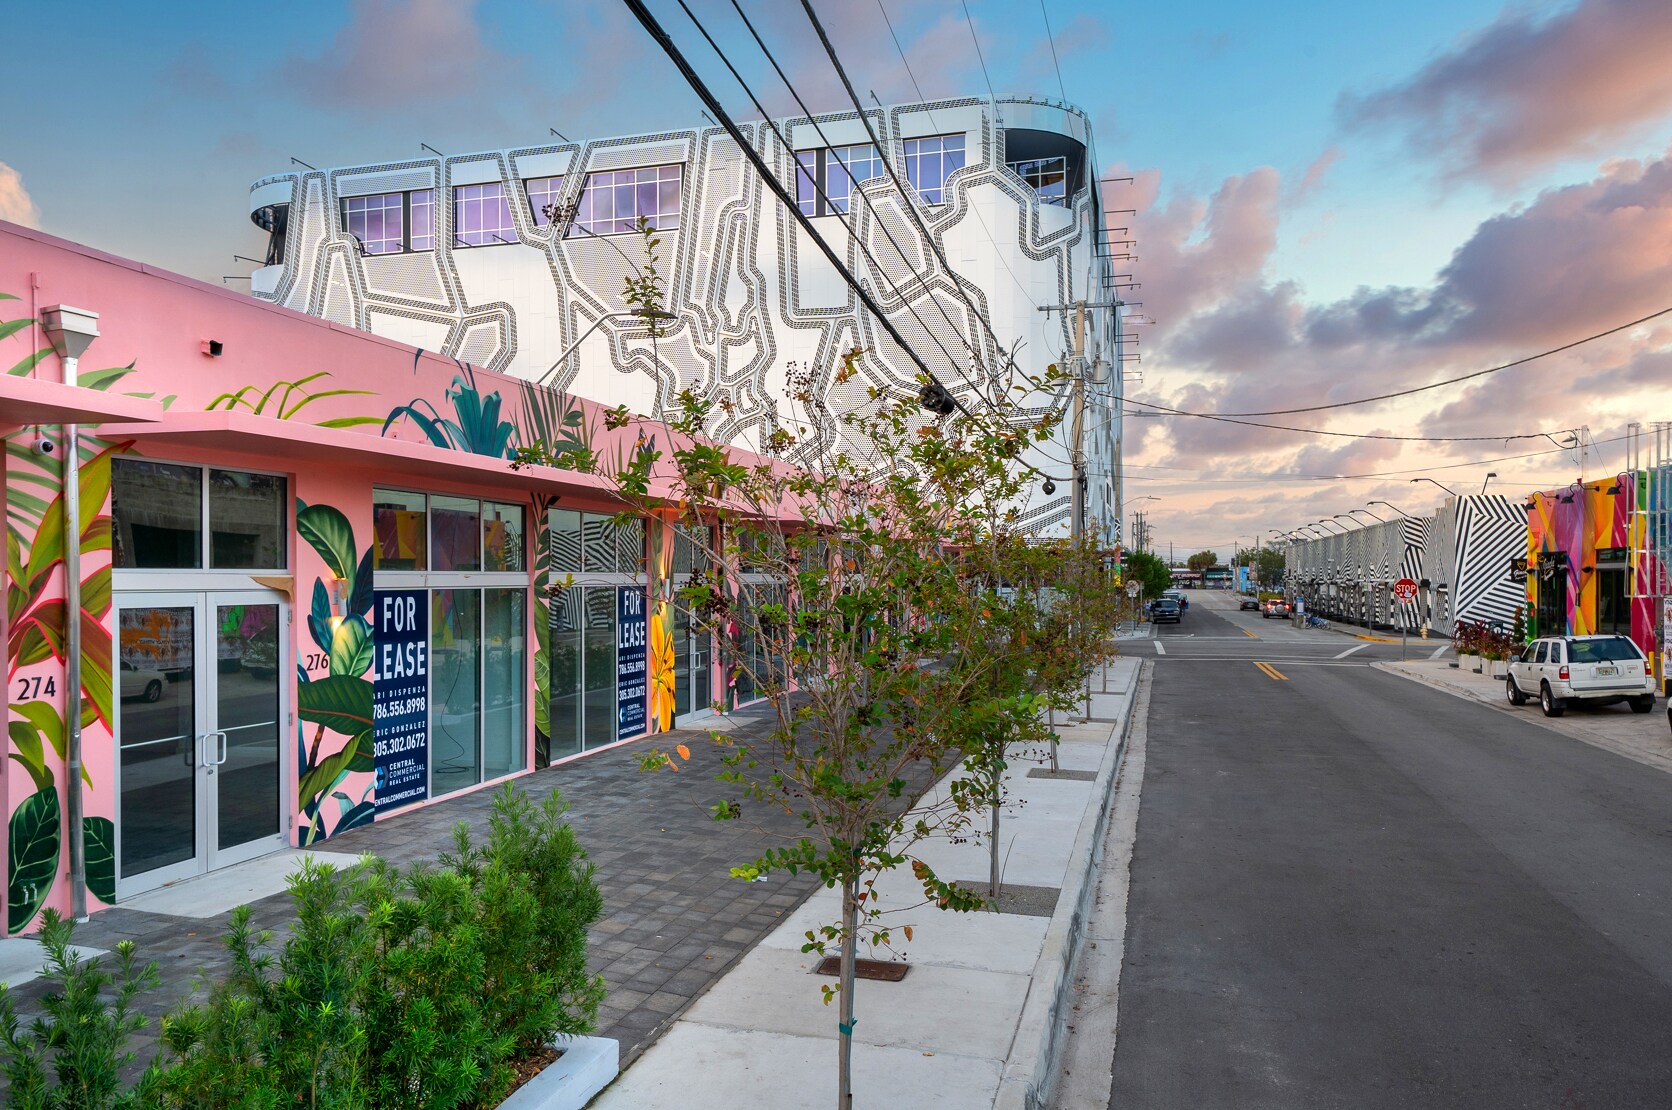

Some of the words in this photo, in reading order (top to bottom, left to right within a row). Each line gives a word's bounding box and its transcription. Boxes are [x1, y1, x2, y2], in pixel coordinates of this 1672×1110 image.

[1396, 584, 1416, 593] STOP
[624, 591, 641, 615] FOR
[383, 596, 416, 632] FOR
[619, 622, 645, 648] LEASE
[306, 653, 329, 671] 276
[373, 641, 426, 681] LEASE
[17, 676, 56, 700] 274
[389, 686, 426, 697] DISPENZA
[373, 697, 426, 720] 786.556.8998
[391, 721, 426, 734] GONZALEZ
[389, 758, 415, 771] CENTRAL
[389, 764, 426, 779] COMMERCIAL
[403, 773, 420, 783] ESTATE
